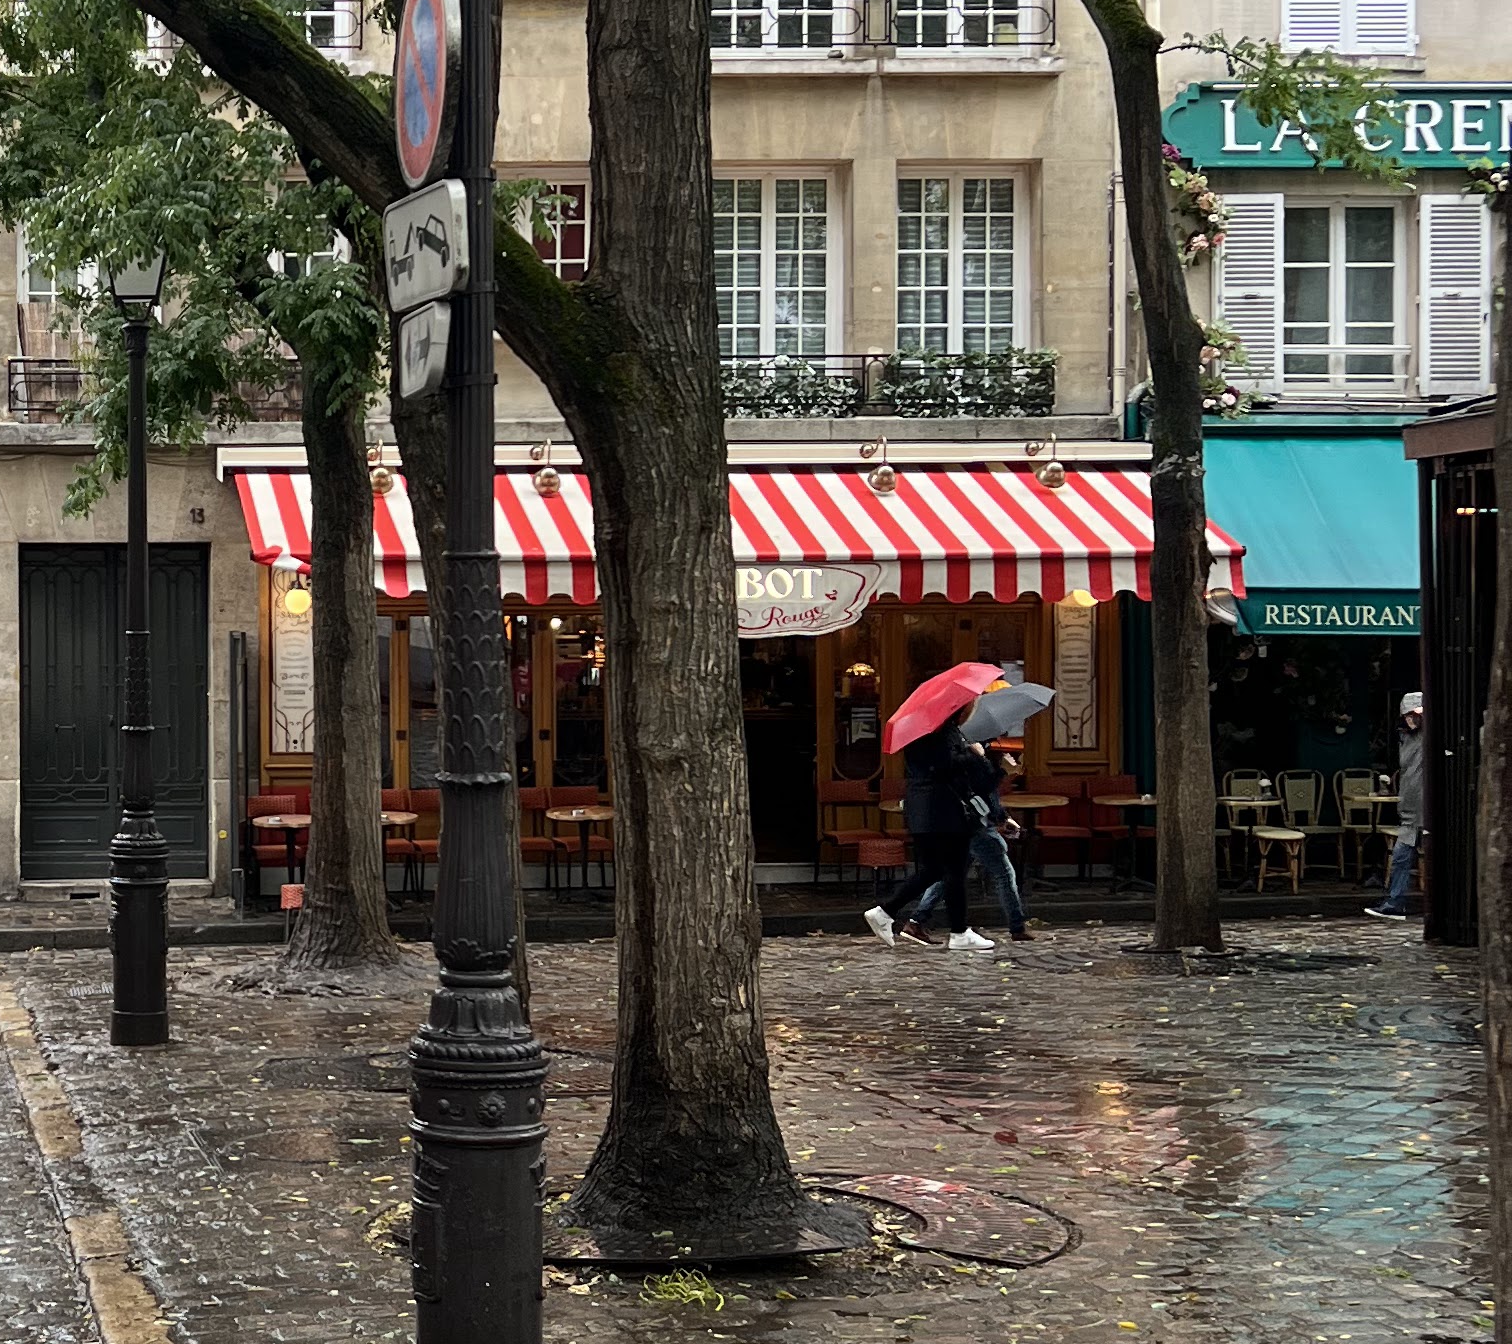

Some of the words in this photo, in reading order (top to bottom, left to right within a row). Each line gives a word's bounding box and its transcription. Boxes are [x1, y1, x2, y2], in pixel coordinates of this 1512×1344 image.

[1219, 98, 1319, 152] LA
[189, 507, 206, 524] 13
[735, 567, 823, 600] BOT
[752, 605, 829, 630] Rouge
